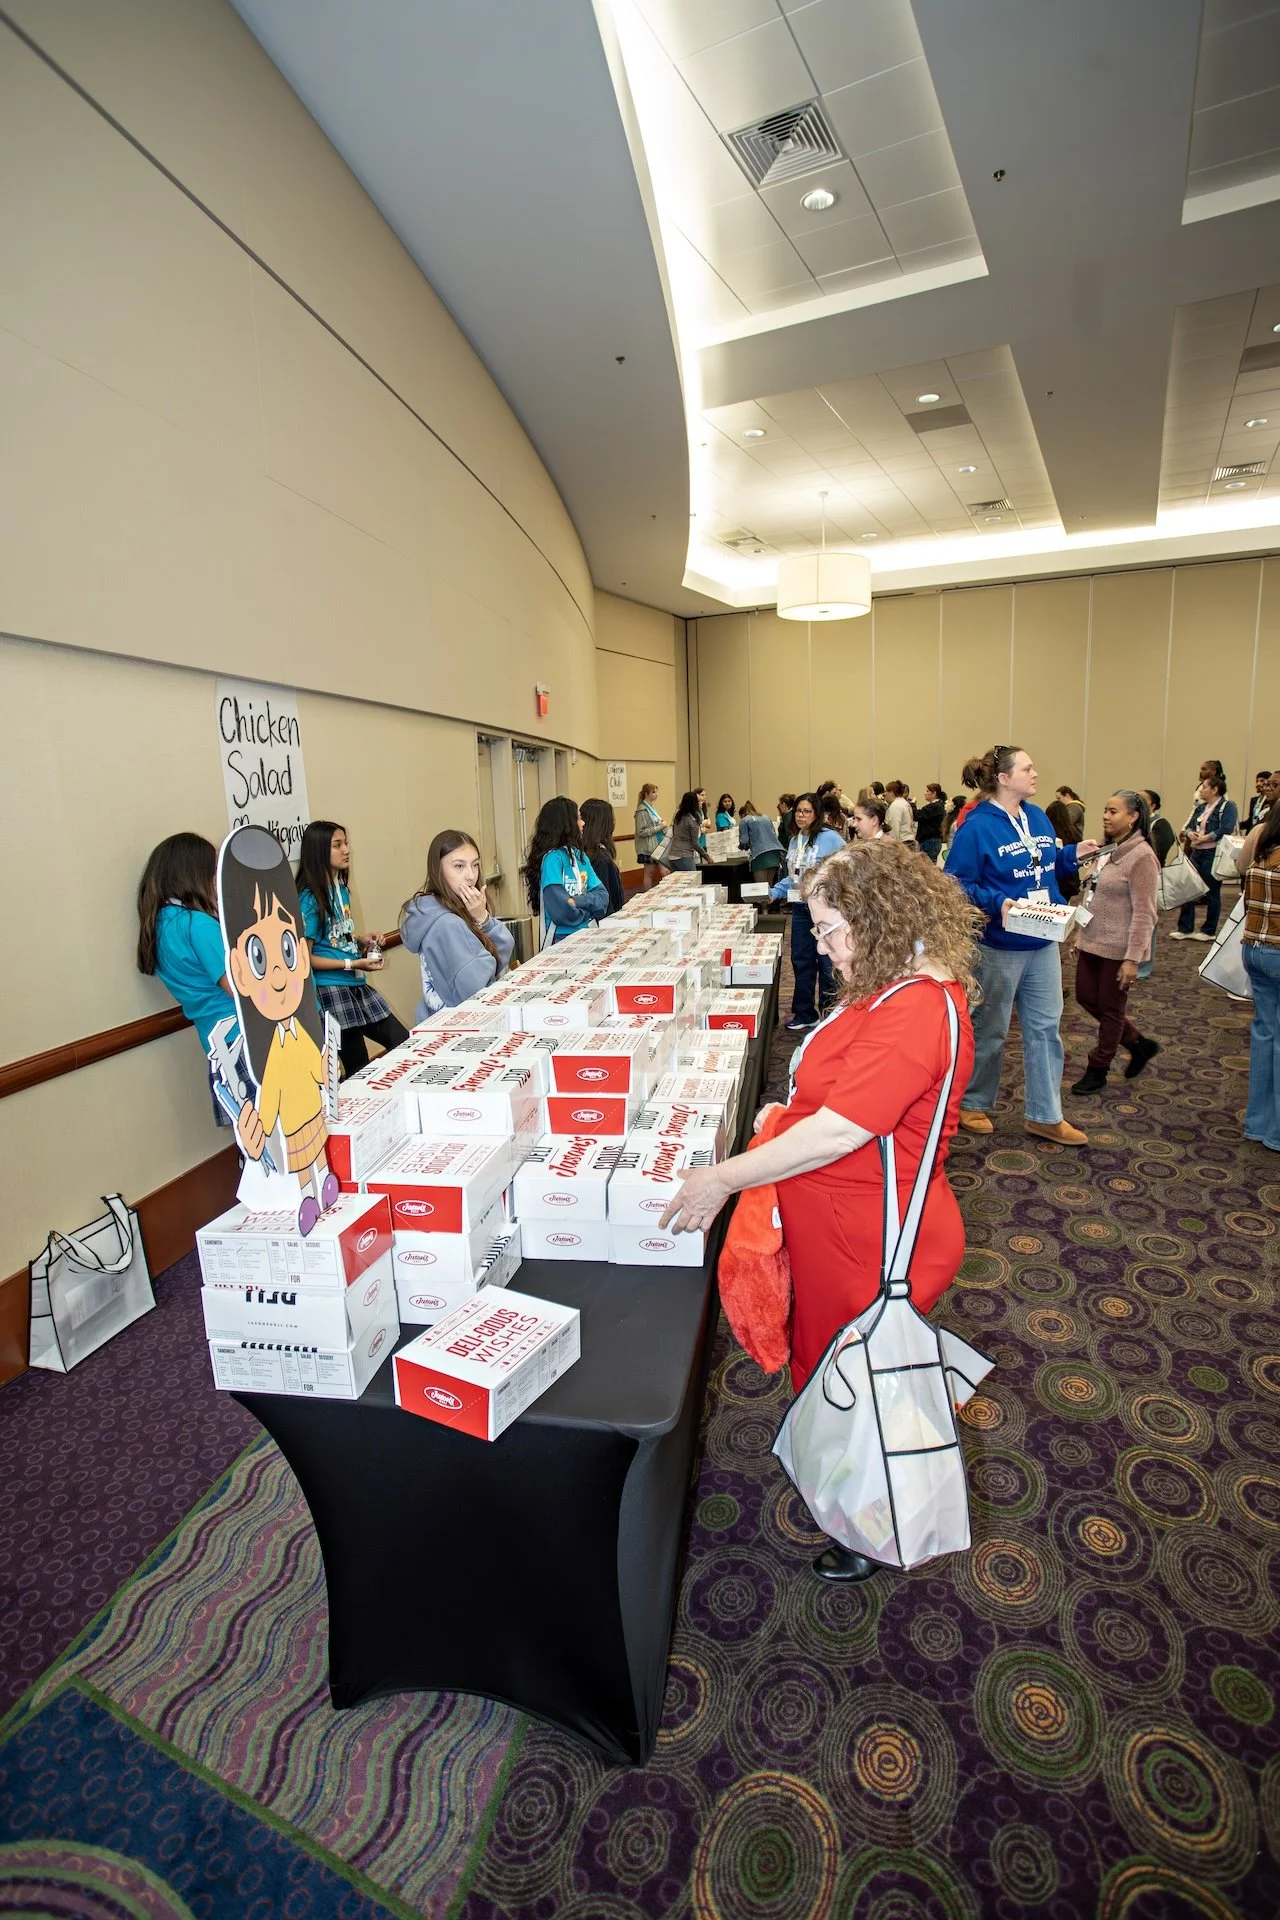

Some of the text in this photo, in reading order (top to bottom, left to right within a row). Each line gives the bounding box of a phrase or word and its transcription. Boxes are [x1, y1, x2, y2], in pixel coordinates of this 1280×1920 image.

[219, 696, 300, 747] Chicken
[227, 750, 293, 809] Salad
[366, 1059, 424, 1090] Jason's
[658, 1103, 698, 1138] Jason's
[549, 1136, 598, 1177] Jason's
[642, 1141, 685, 1183] Jason's
[549, 1195, 571, 1203] Jason's
[552, 1235, 574, 1244] Jason's
[645, 1240, 668, 1248] Jason's
[404, 1253, 429, 1262] Jason's
[290, 1275, 301, 1284] FOR
[415, 1297, 440, 1307] Jason's
[445, 1308, 519, 1358] DELI-CIOUS
[469, 1315, 538, 1363] WISHES
[303, 1383, 314, 1392] FOR
